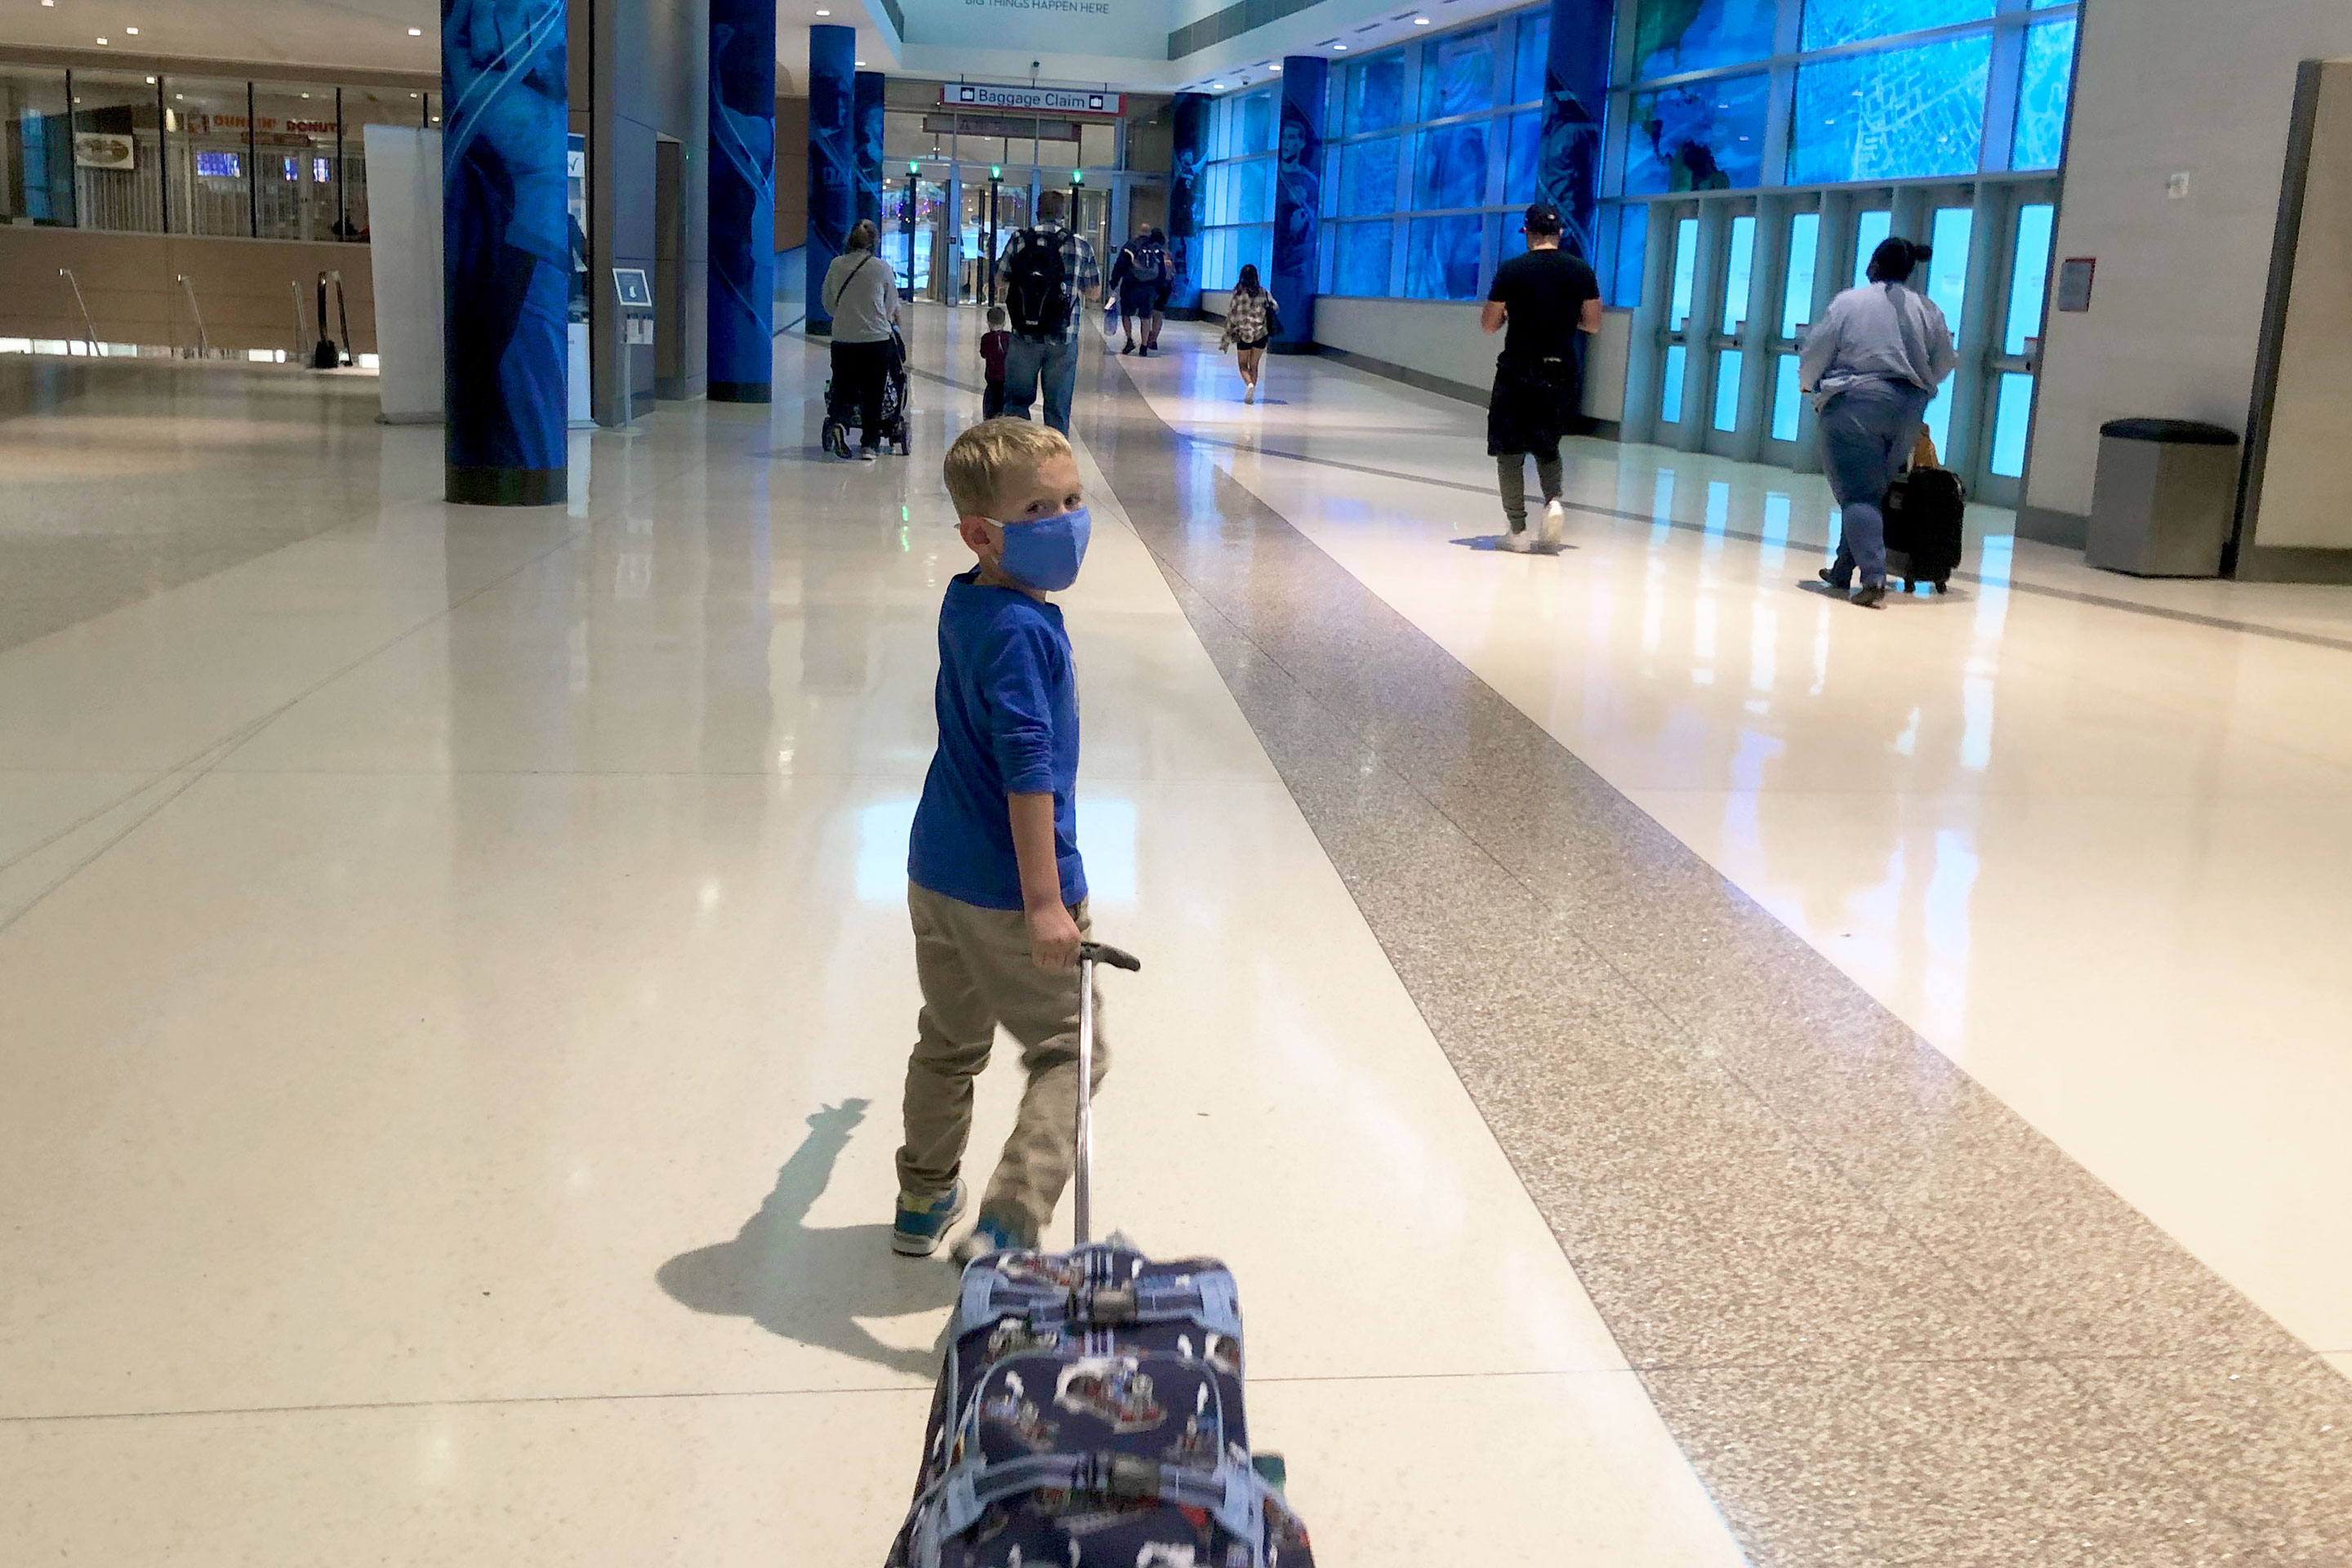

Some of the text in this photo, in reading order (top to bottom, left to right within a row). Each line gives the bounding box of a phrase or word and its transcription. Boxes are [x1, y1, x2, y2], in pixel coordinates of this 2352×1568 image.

[988, 0, 1030, 9] THINGS
[1032, 2, 1077, 12] HAPPEN
[1080, 3, 1110, 14] HERE
[979, 89, 1085, 108] Baggage Claim
[213, 114, 276, 129] DUNIN'
